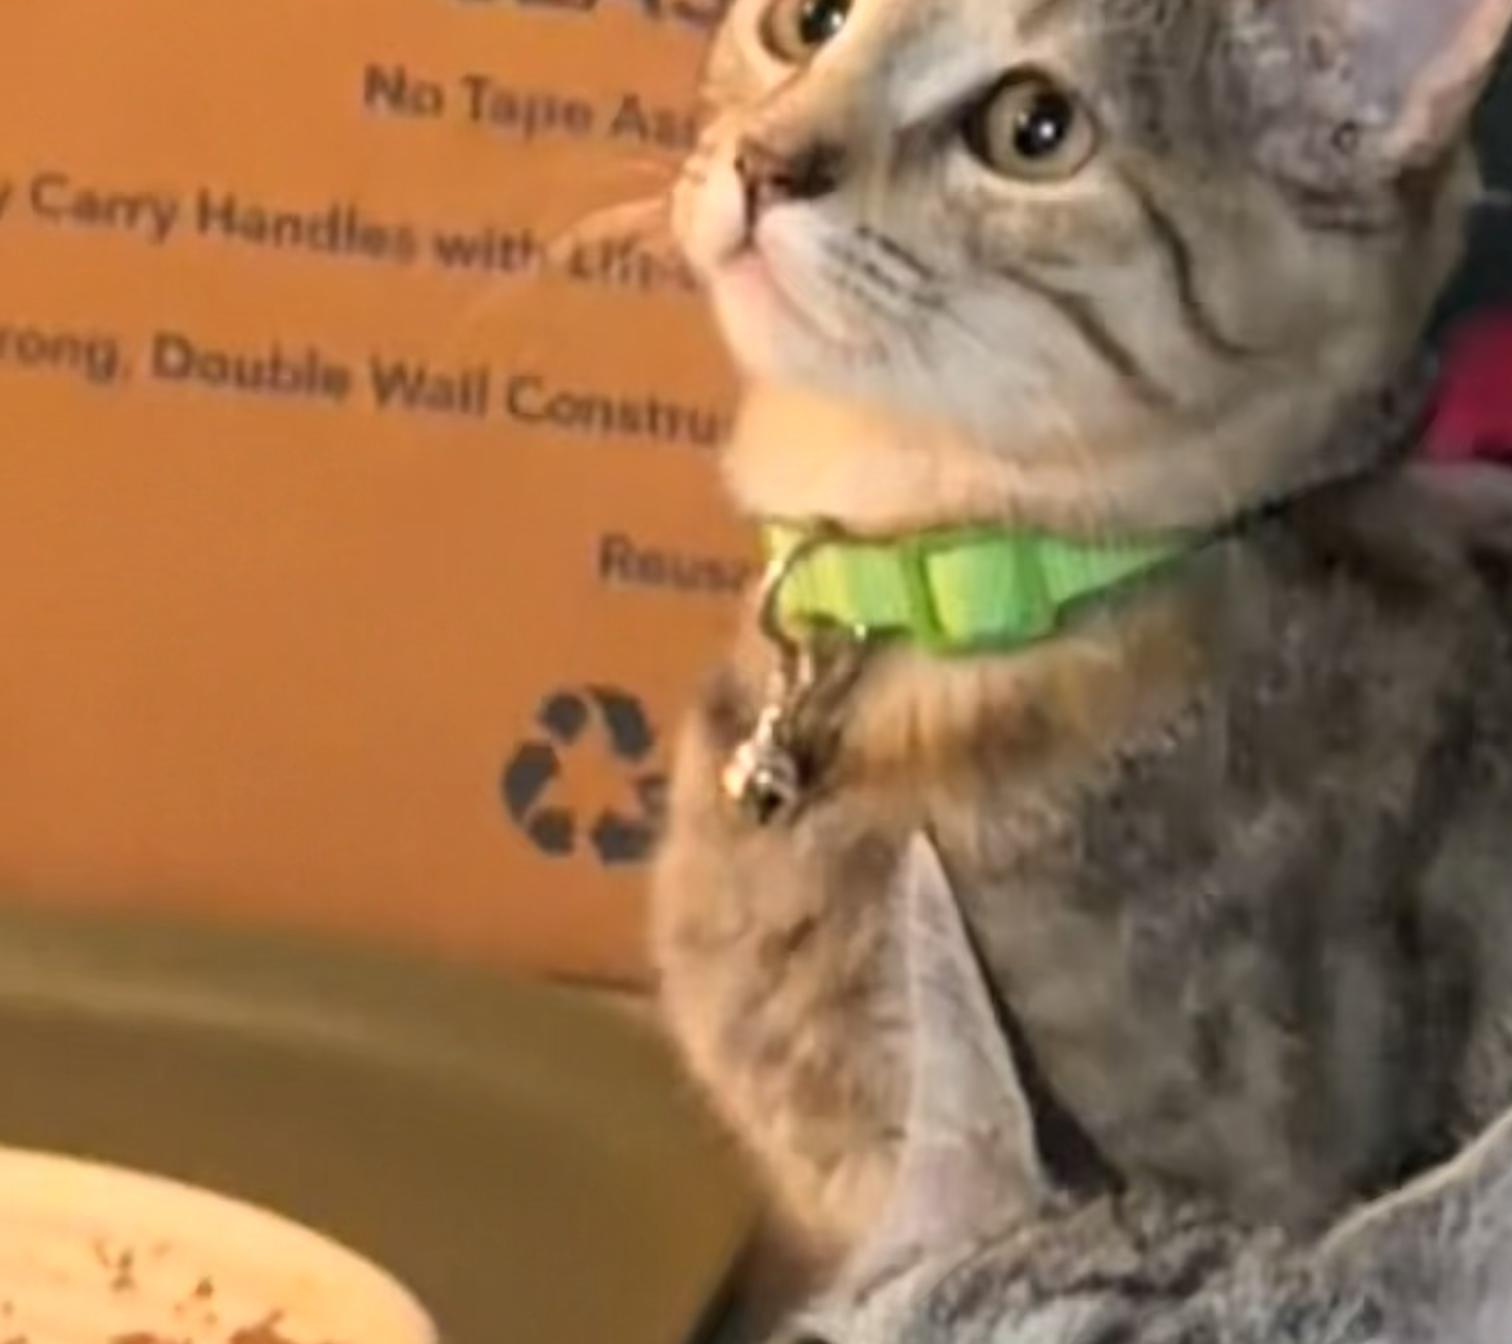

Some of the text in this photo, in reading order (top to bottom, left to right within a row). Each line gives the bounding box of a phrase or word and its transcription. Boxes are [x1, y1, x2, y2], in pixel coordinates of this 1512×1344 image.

[363, 64, 444, 119] No
[459, 74, 594, 135] Tape
[30, 172, 180, 248] Carry
[197, 186, 414, 266] Handles
[433, 231, 546, 275] with
[151, 330, 351, 401] Double
[369, 356, 489, 419] Wall
[505, 374, 730, 449] Constru
